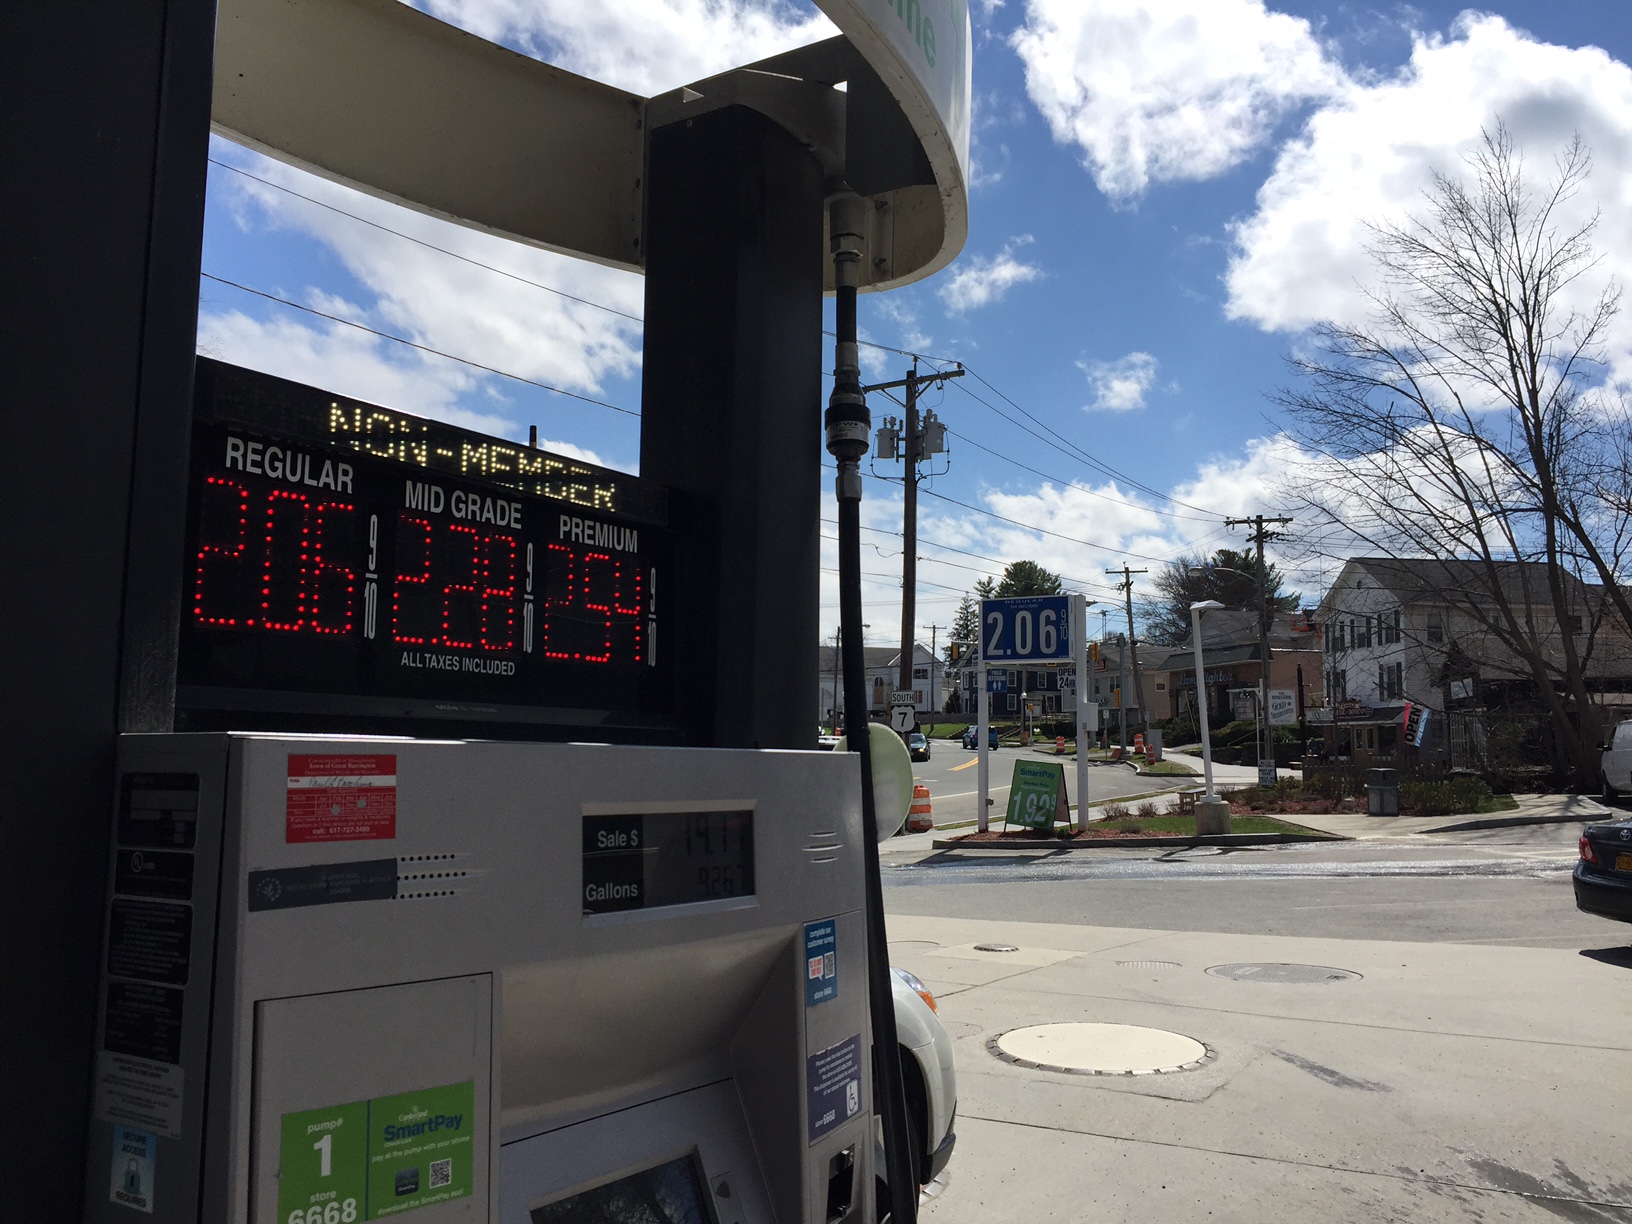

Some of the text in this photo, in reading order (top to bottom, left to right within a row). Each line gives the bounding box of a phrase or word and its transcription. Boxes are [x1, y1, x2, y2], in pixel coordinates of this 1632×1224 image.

[225, 436, 354, 494] REGULAR
[405, 480, 522, 529] MID GRADE
[559, 514, 638, 553] PREMIUM
[1061, 609, 1067, 623] 9
[986, 609, 1057, 656] 2.06
[1060, 626, 1067, 640] 10
[401, 651, 515, 676] ALL TAXES INCLUDED
[1058, 668, 1076, 676] OPEN
[1059, 677, 1069, 688] 24
[1178, 670, 1234, 686] Lamighter
[892, 693, 914, 702] SOUTH
[898, 712, 907, 727] 7
[1404, 705, 1422, 743] OPEN
[1020, 768, 1056, 779] SmartPay
[598, 829, 638, 848] Sale $
[585, 882, 638, 901] Gallons
[307, 1117, 343, 1135] pump#
[384, 1114, 463, 1142] SmartPay
[313, 1134, 332, 1177] 1
[310, 1190, 337, 1203] store
[288, 1197, 357, 1224] 6668
